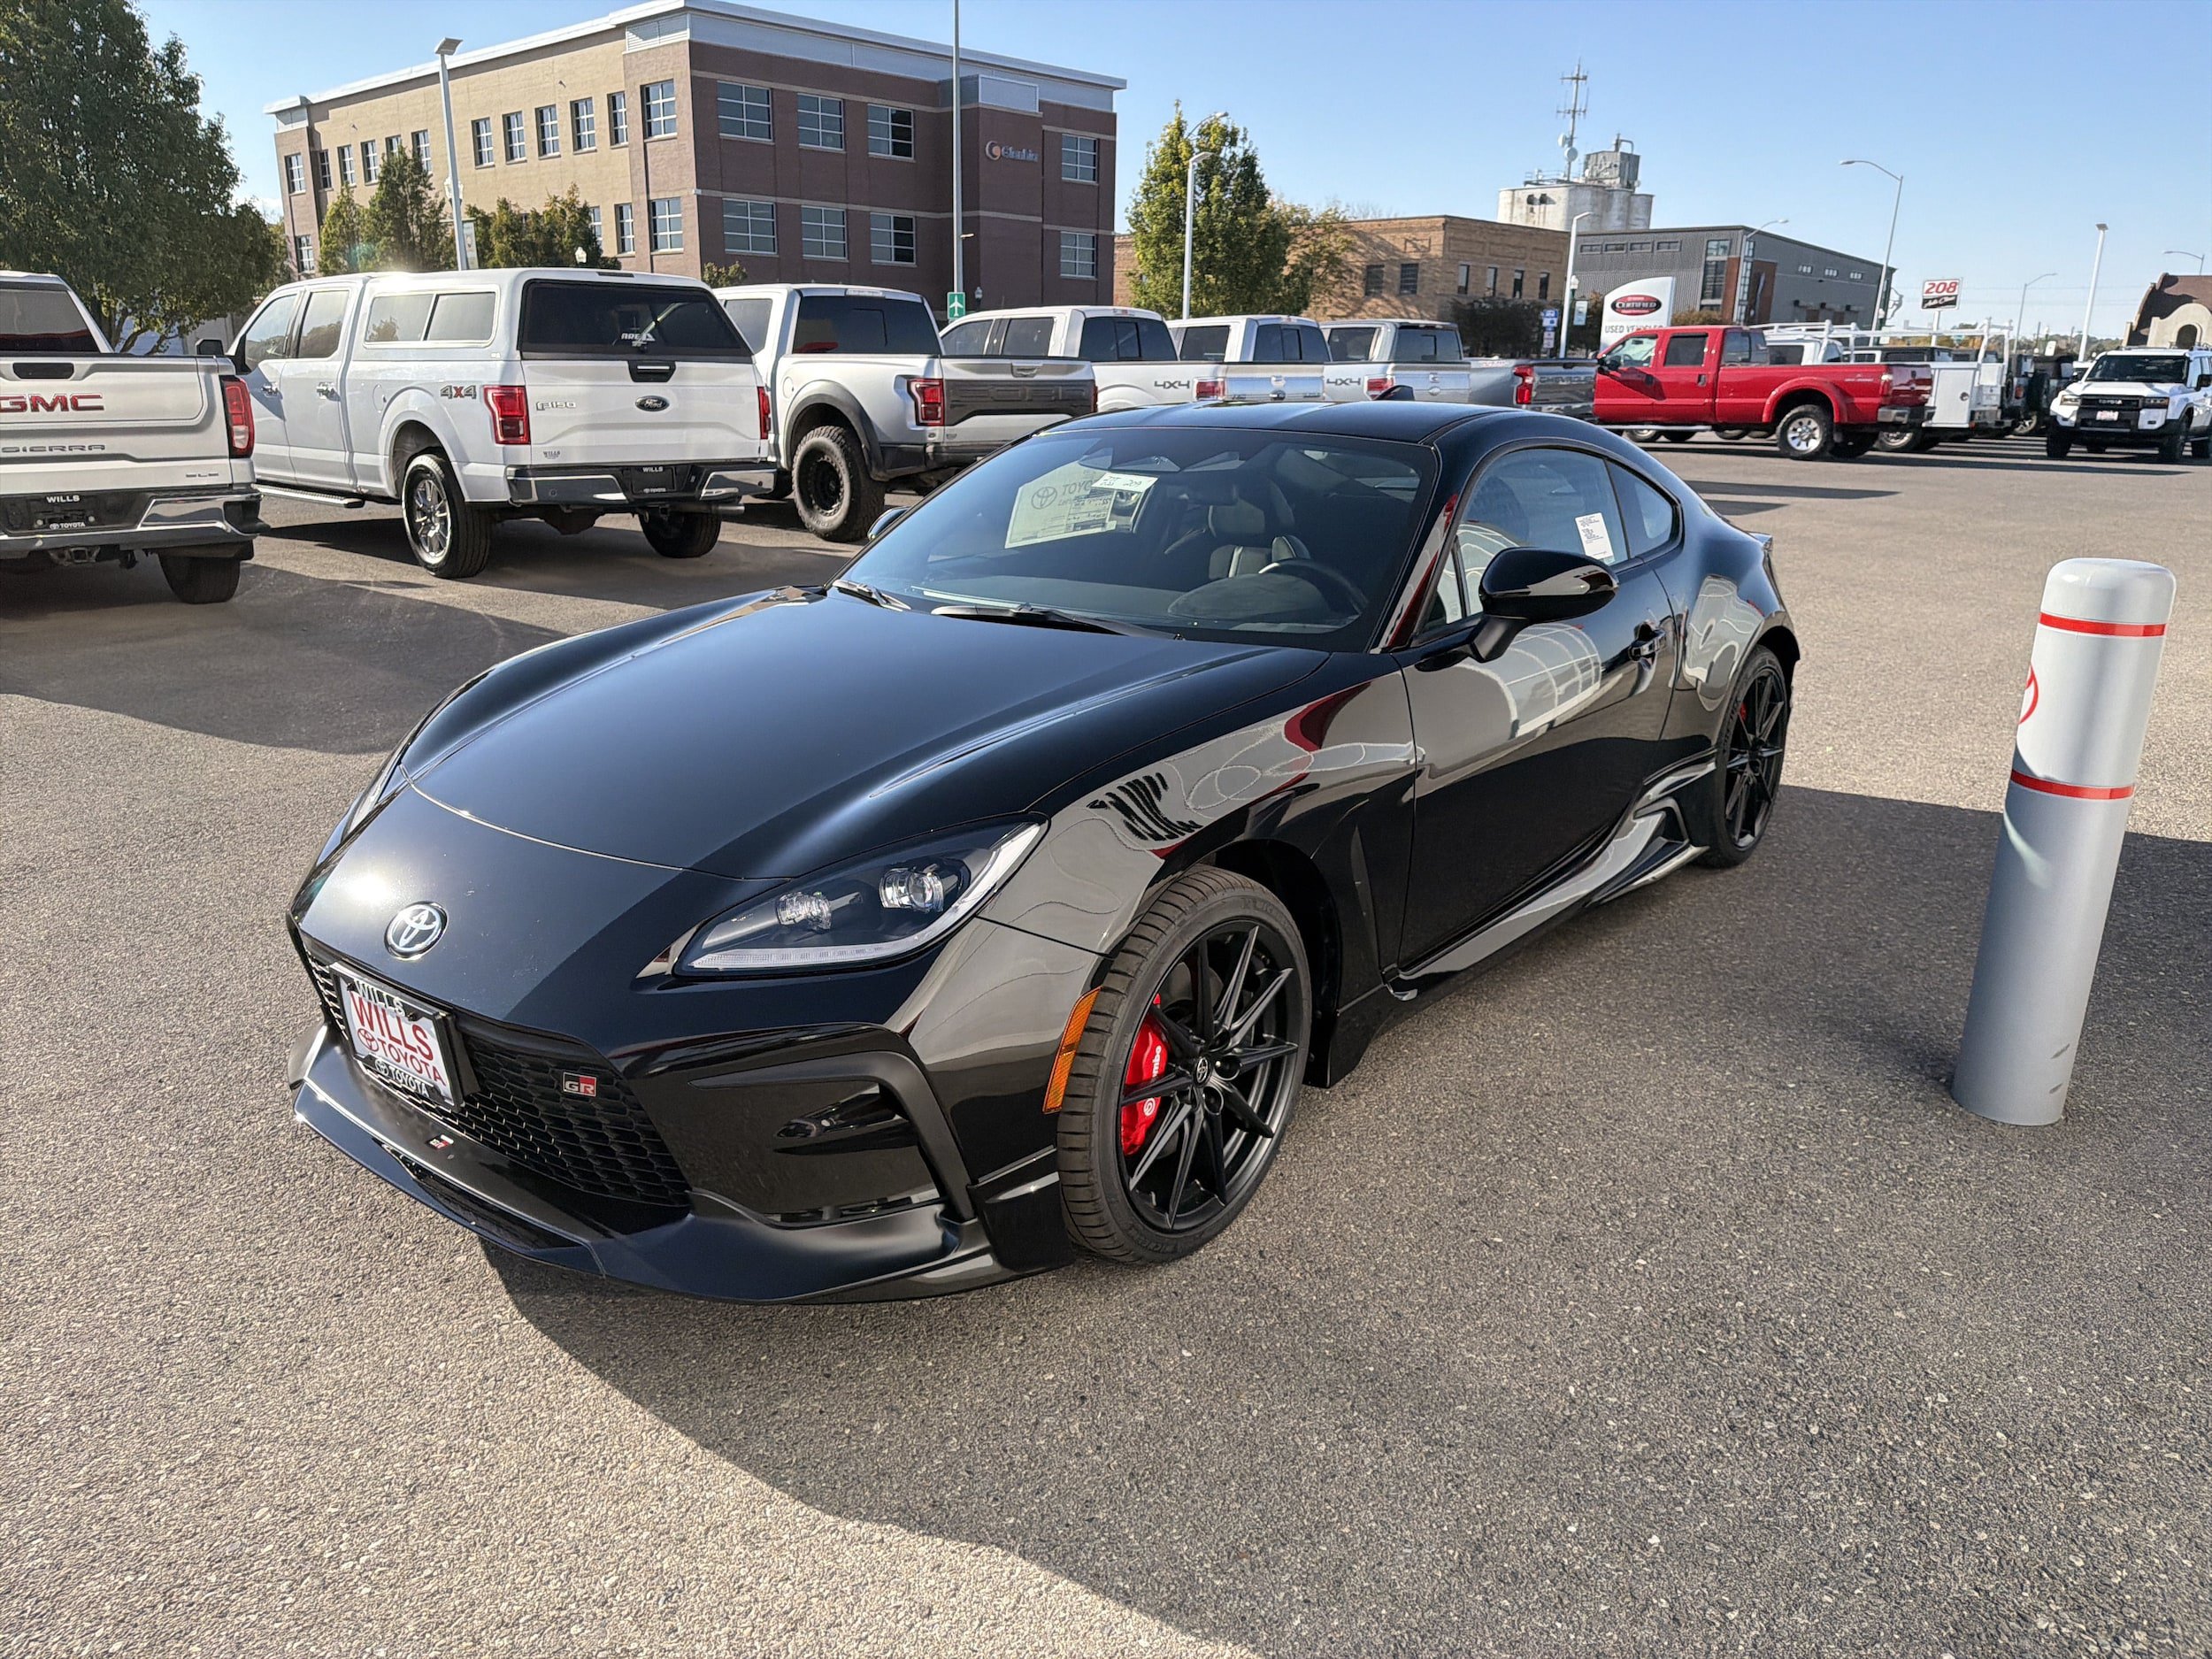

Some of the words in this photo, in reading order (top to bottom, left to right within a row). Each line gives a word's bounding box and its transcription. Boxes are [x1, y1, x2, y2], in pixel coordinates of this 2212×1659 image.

[1924, 281, 1958, 295] 208
[1604, 325, 1625, 334] USED
[0, 393, 104, 413] GMC
[1, 444, 106, 454] SIERRA
[1062, 480, 1093, 495] TOYO
[46, 495, 81, 503] WILLS
[354, 979, 406, 1017] WILLS
[349, 990, 434, 1061] WILLS
[378, 1038, 447, 1087] TOYOTA
[388, 1064, 430, 1098] TOYOTA
[565, 1080, 595, 1094] GR
